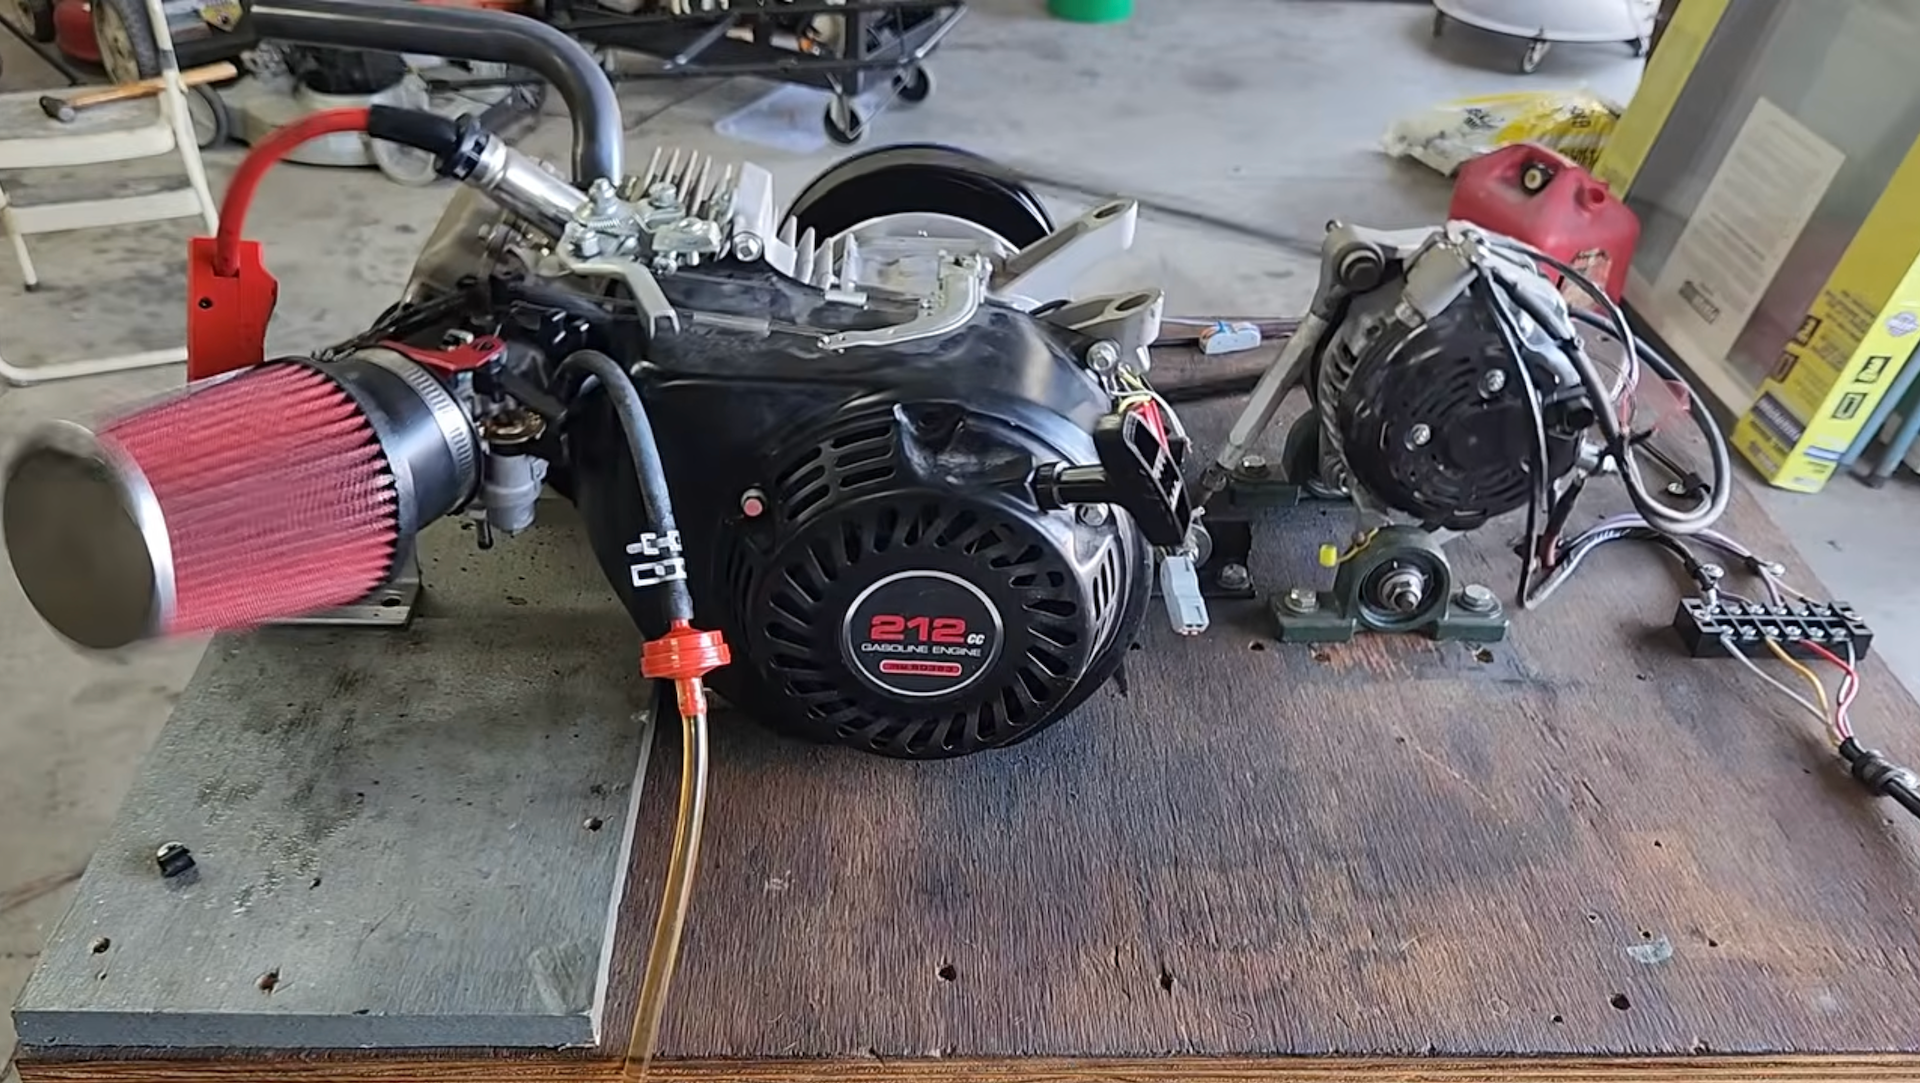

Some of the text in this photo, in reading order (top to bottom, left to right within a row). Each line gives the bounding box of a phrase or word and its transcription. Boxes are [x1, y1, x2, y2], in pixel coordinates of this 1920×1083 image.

[870, 614, 966, 643] 212
[861, 643, 981, 657] GASOLINE ENGINE
